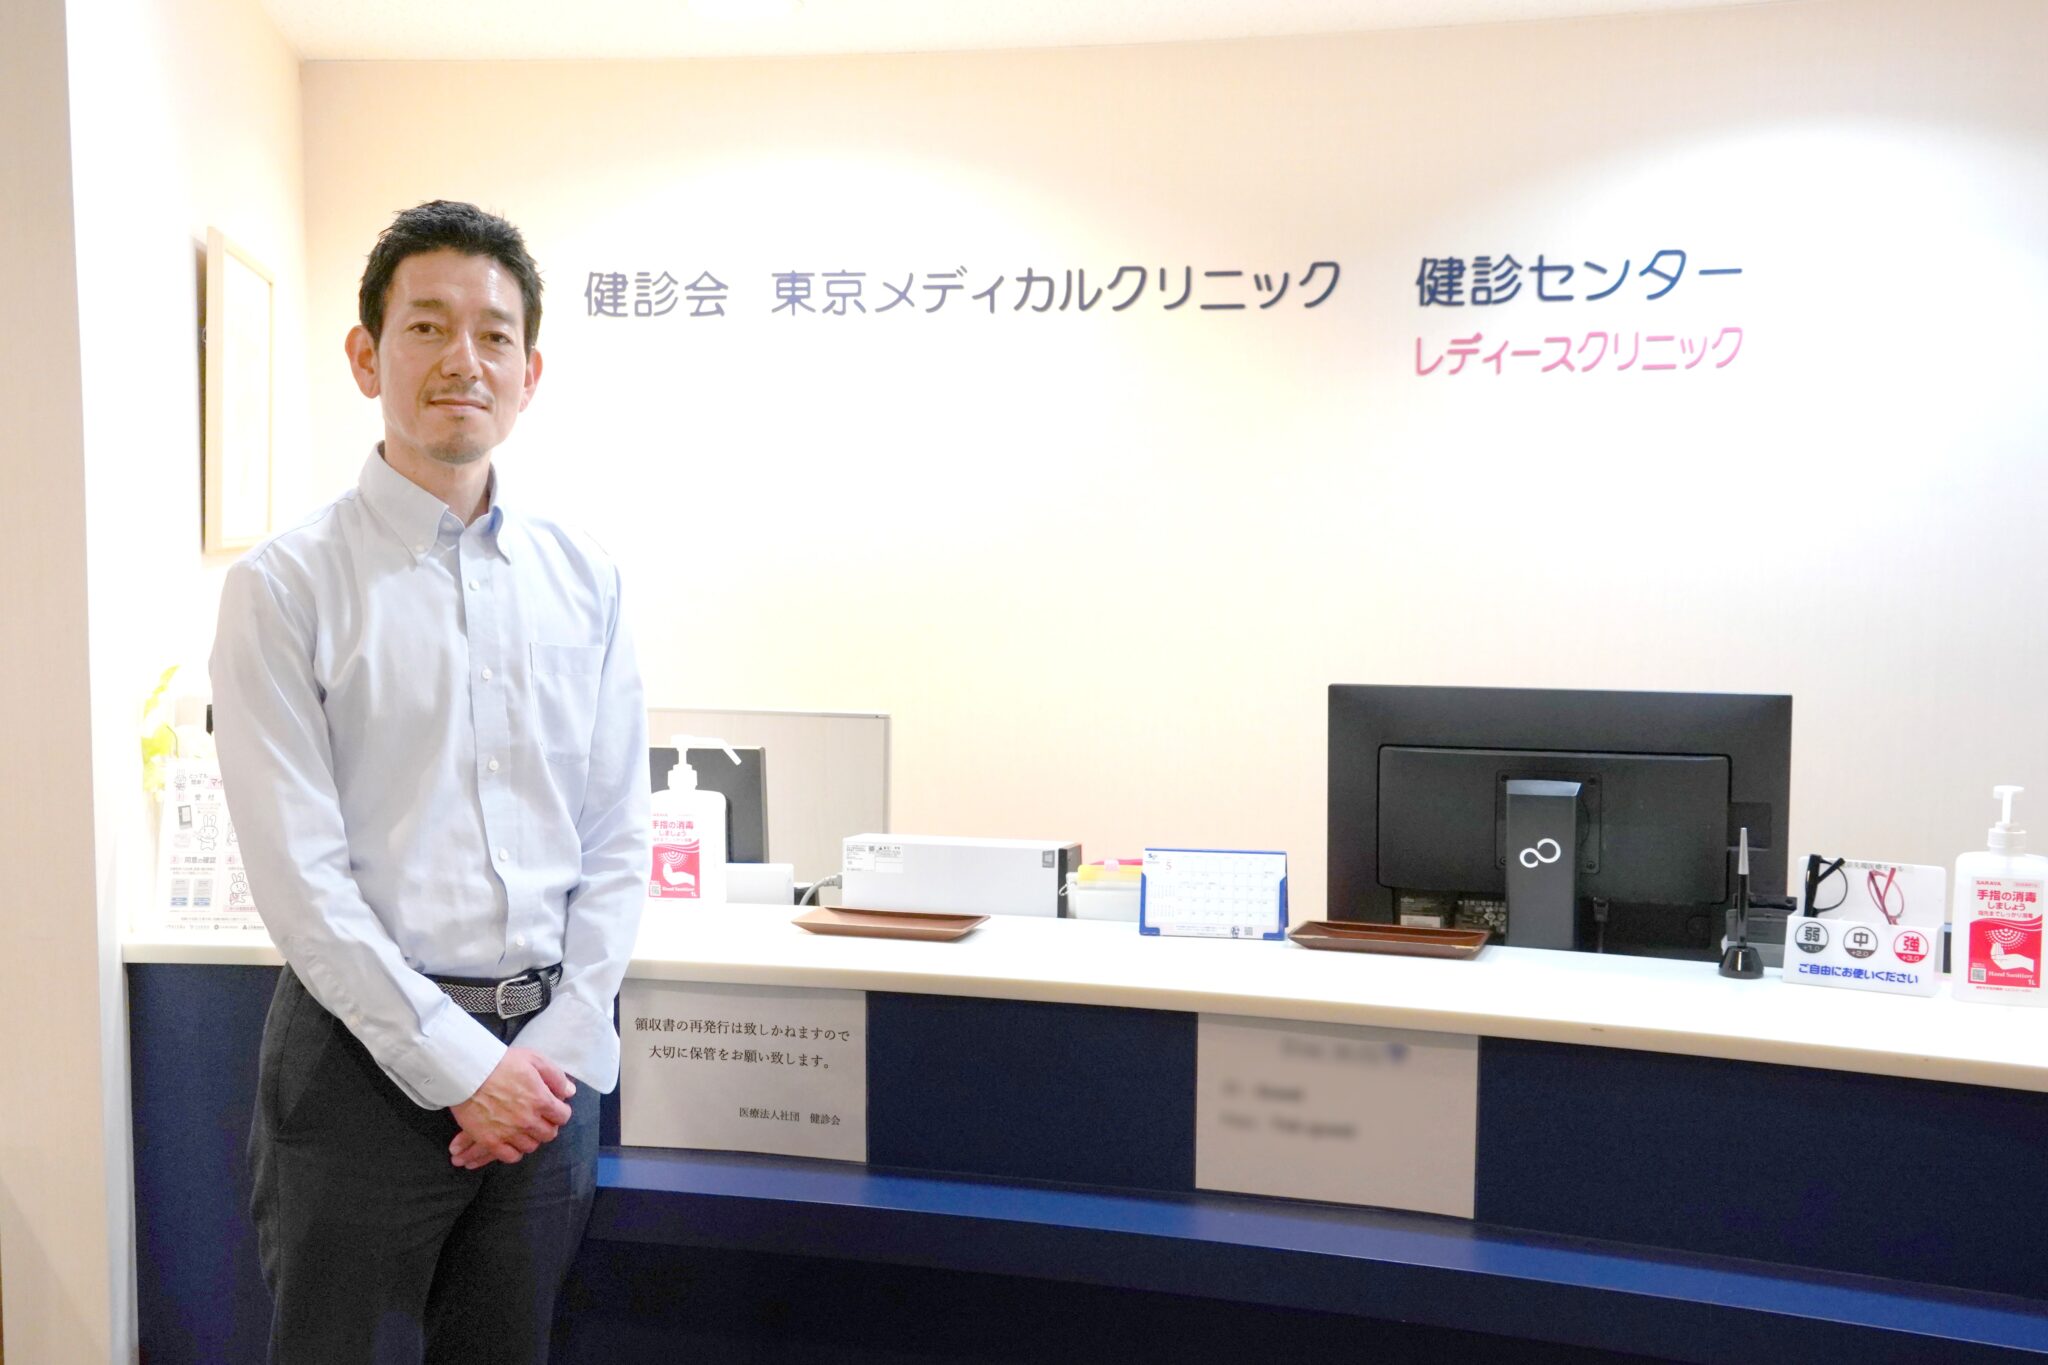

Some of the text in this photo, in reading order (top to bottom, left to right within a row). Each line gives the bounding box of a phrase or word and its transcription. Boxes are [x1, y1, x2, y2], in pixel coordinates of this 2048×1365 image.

[1415, 249, 1743, 307] 健診センター
[584, 261, 1341, 318] 健診会 東京メディカルクリニック
[1415, 327, 1743, 377] レディースクリニック
[652, 820, 694, 830] 手指の消毒
[1977, 889, 2036, 903] 手指の消毒
[1987, 902, 2026, 911] しましょう
[1804, 926, 1820, 942] 弱
[1853, 932, 1869, 947] 中
[1903, 936, 1920, 953] 強
[1798, 963, 1919, 984] ご自由にお使いください
[635, 1017, 850, 1042] 領収書の再発行は致しかねますので
[649, 1045, 829, 1069] 大切に保管をお願い致します。
[739, 1106, 841, 1126] 医療法人社団 健診会
